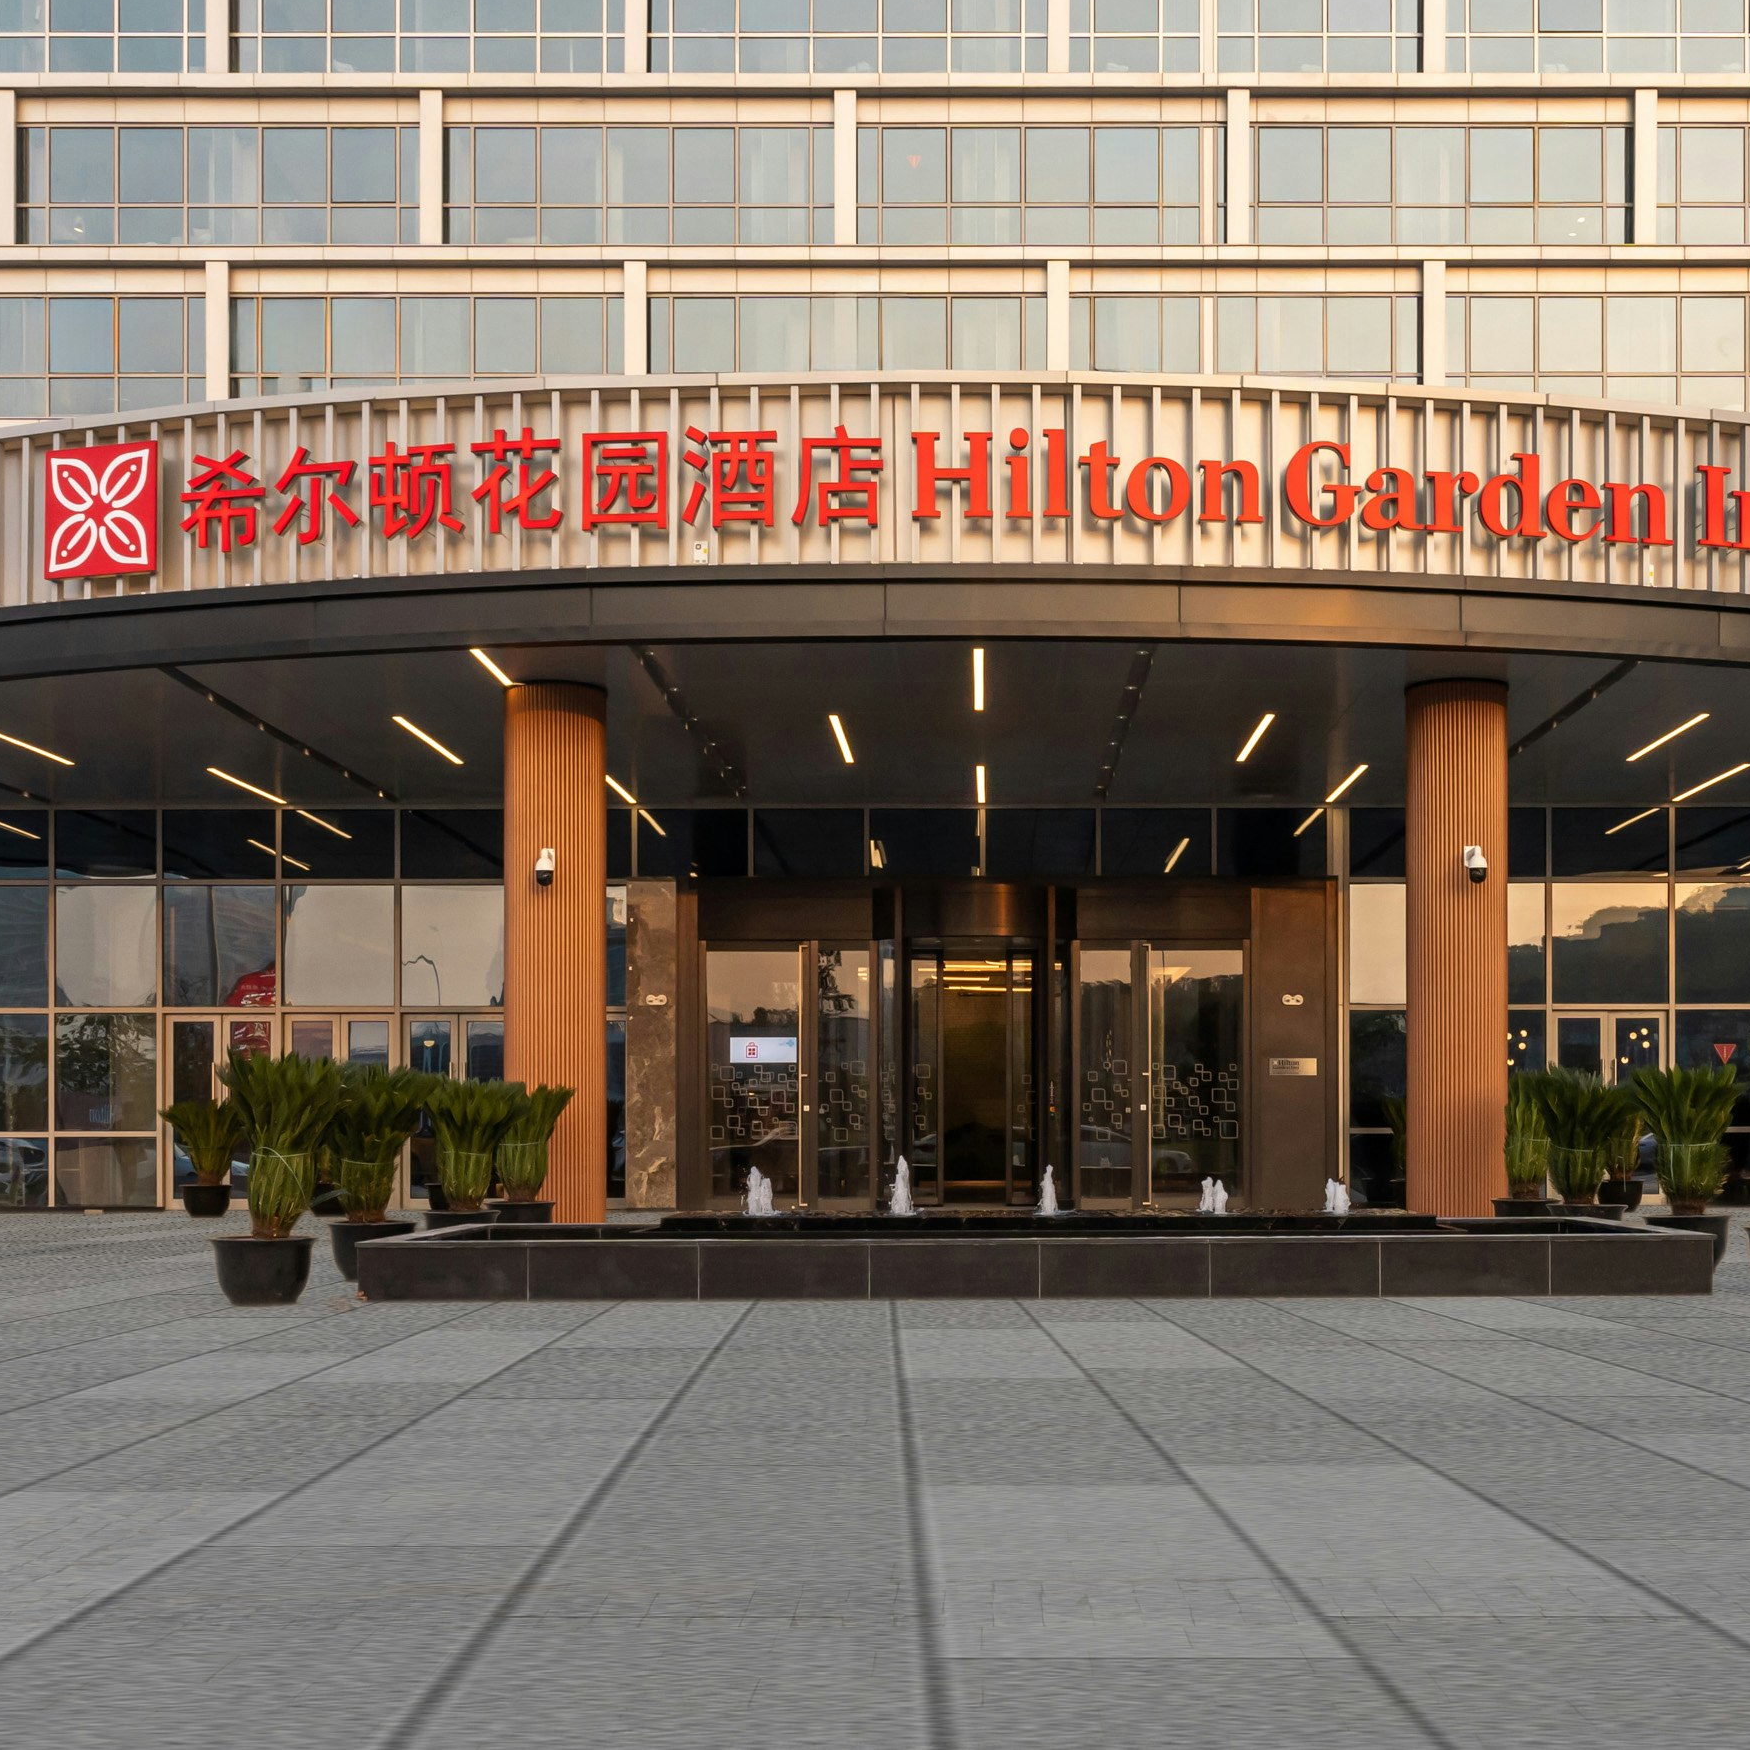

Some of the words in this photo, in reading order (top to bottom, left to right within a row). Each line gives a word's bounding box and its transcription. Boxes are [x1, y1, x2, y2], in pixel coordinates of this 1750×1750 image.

[178, 424, 887, 553] 希尔顿花园酒店
[910, 428, 1266, 524] Hilton
[1285, 440, 1676, 546] Garden
